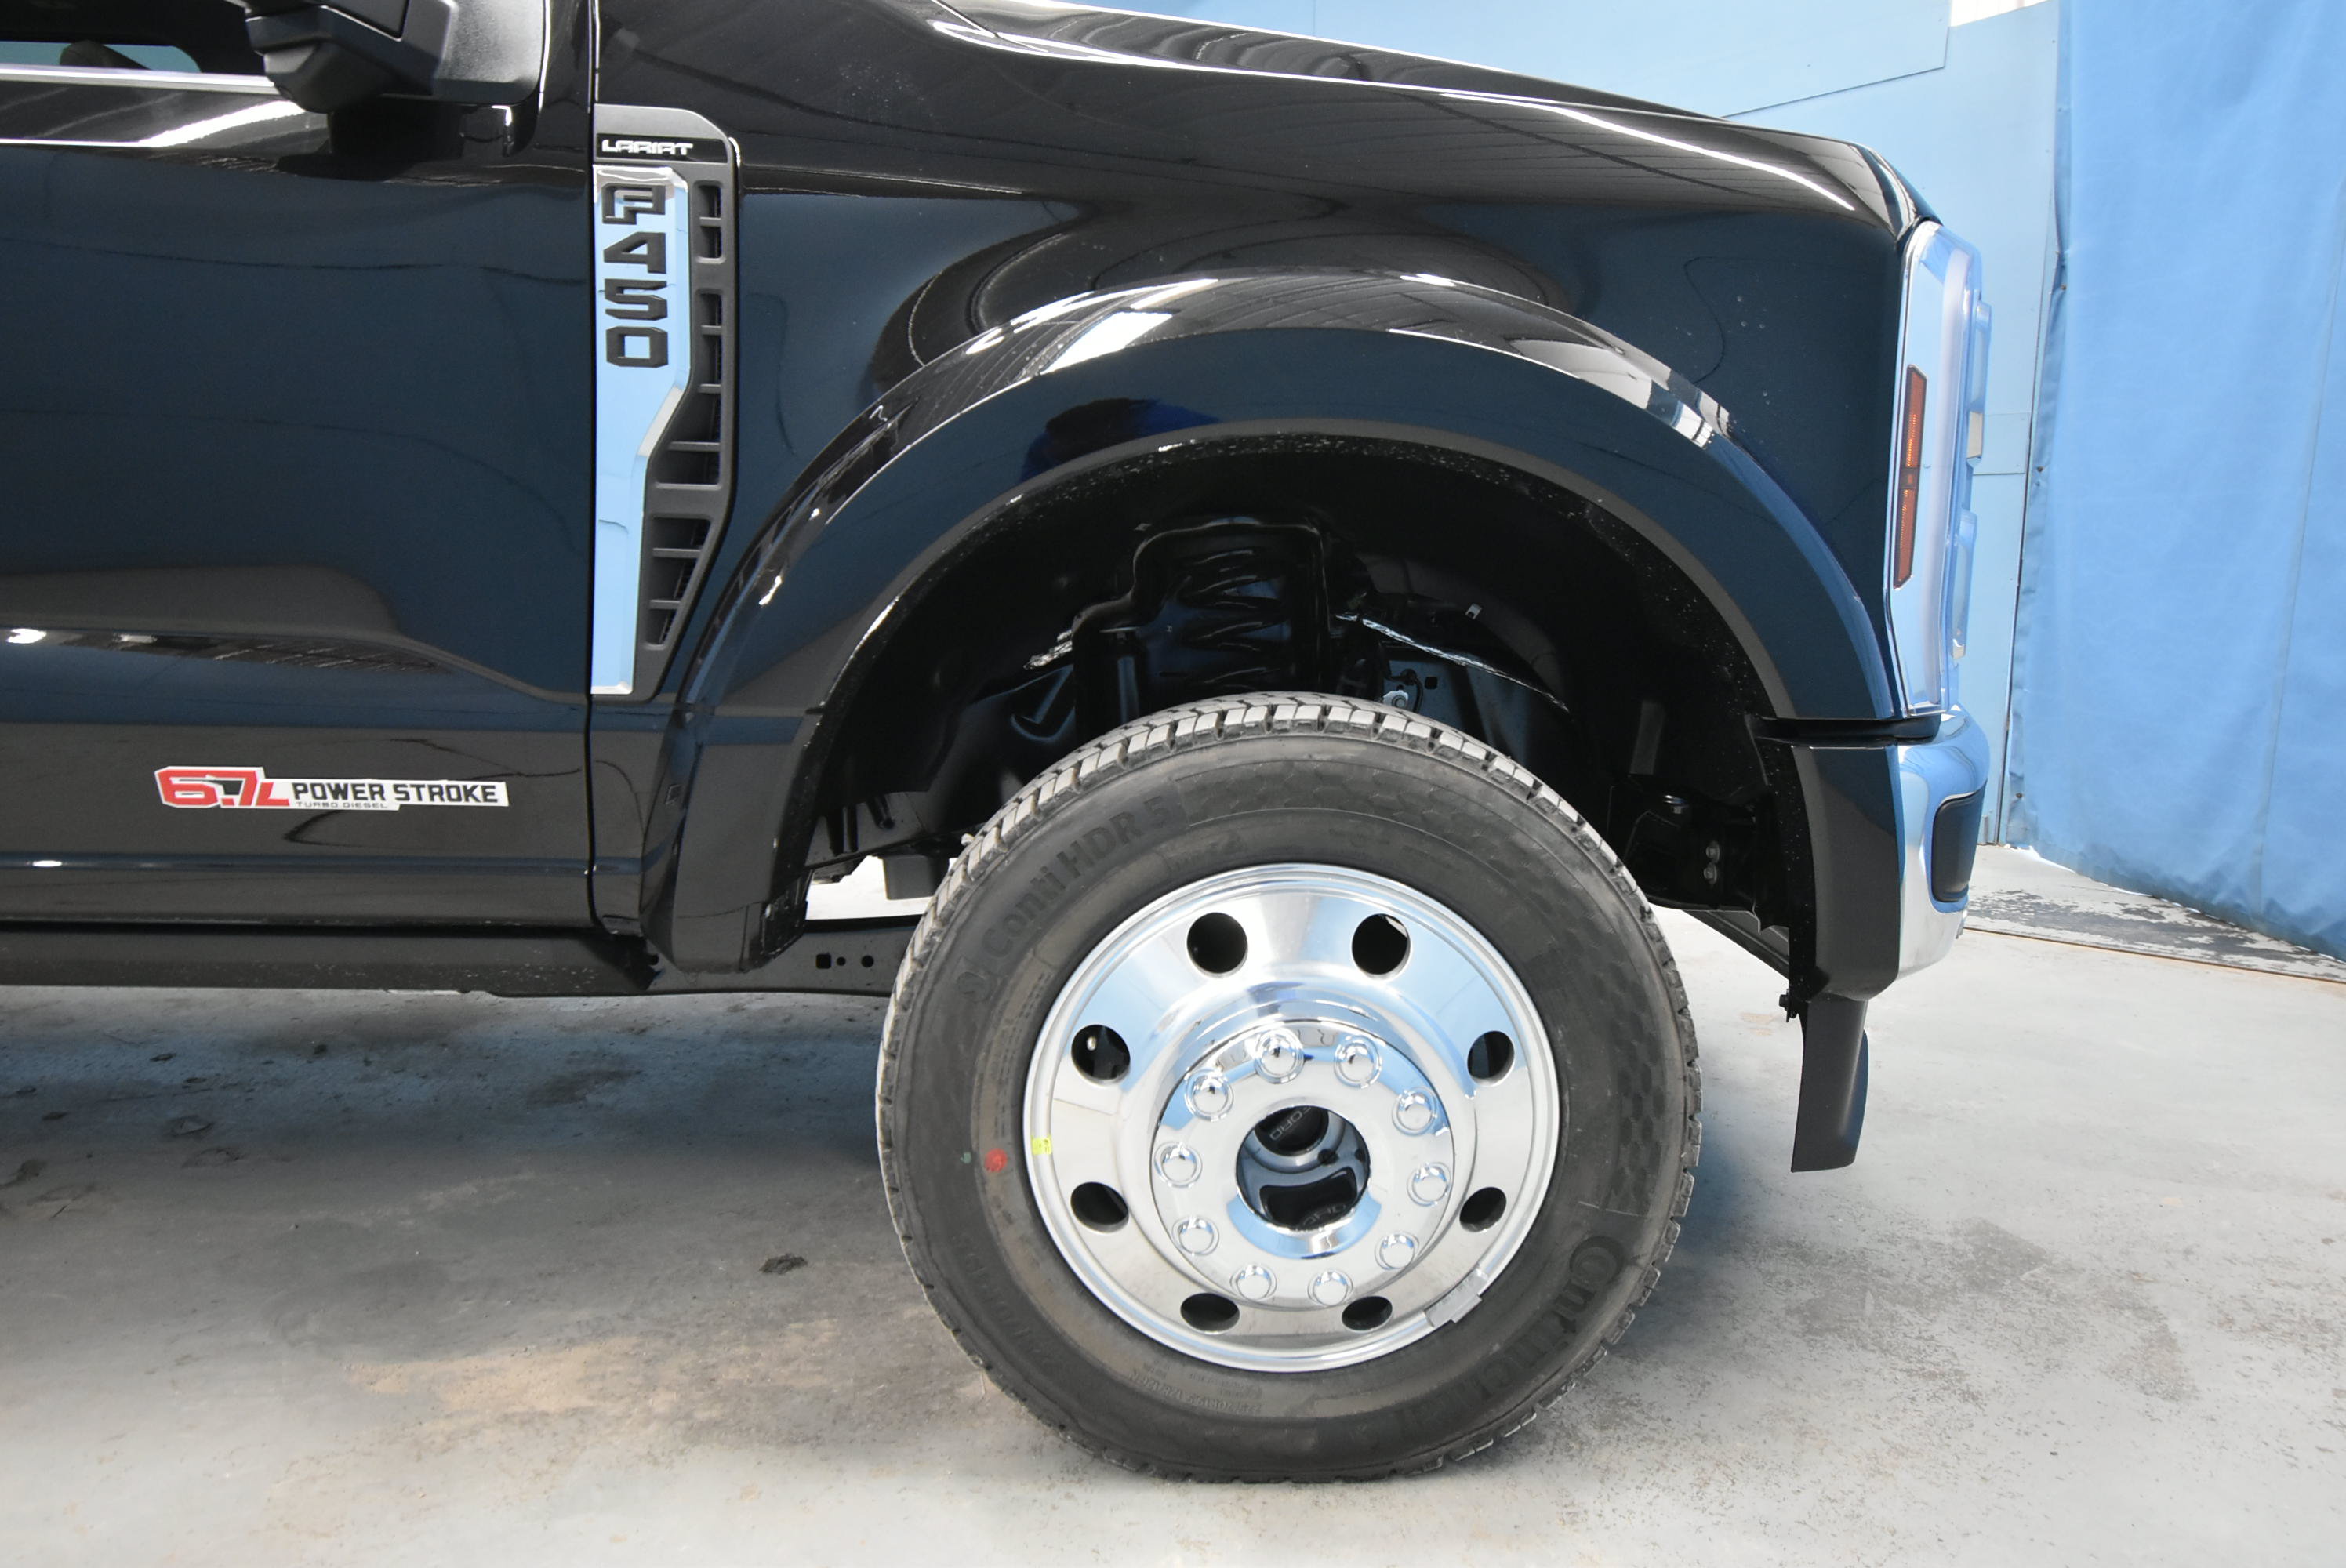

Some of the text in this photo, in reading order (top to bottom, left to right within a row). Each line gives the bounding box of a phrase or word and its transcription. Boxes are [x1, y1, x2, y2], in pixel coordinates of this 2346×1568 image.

[601, 139, 694, 156] LARIAT
[601, 183, 669, 368] F450
[157, 768, 499, 807] 6.7L POWER STROKE
[982, 866, 1067, 958] Conti
[1055, 811, 1143, 878] HDR
[1143, 795, 1171, 828] 5
